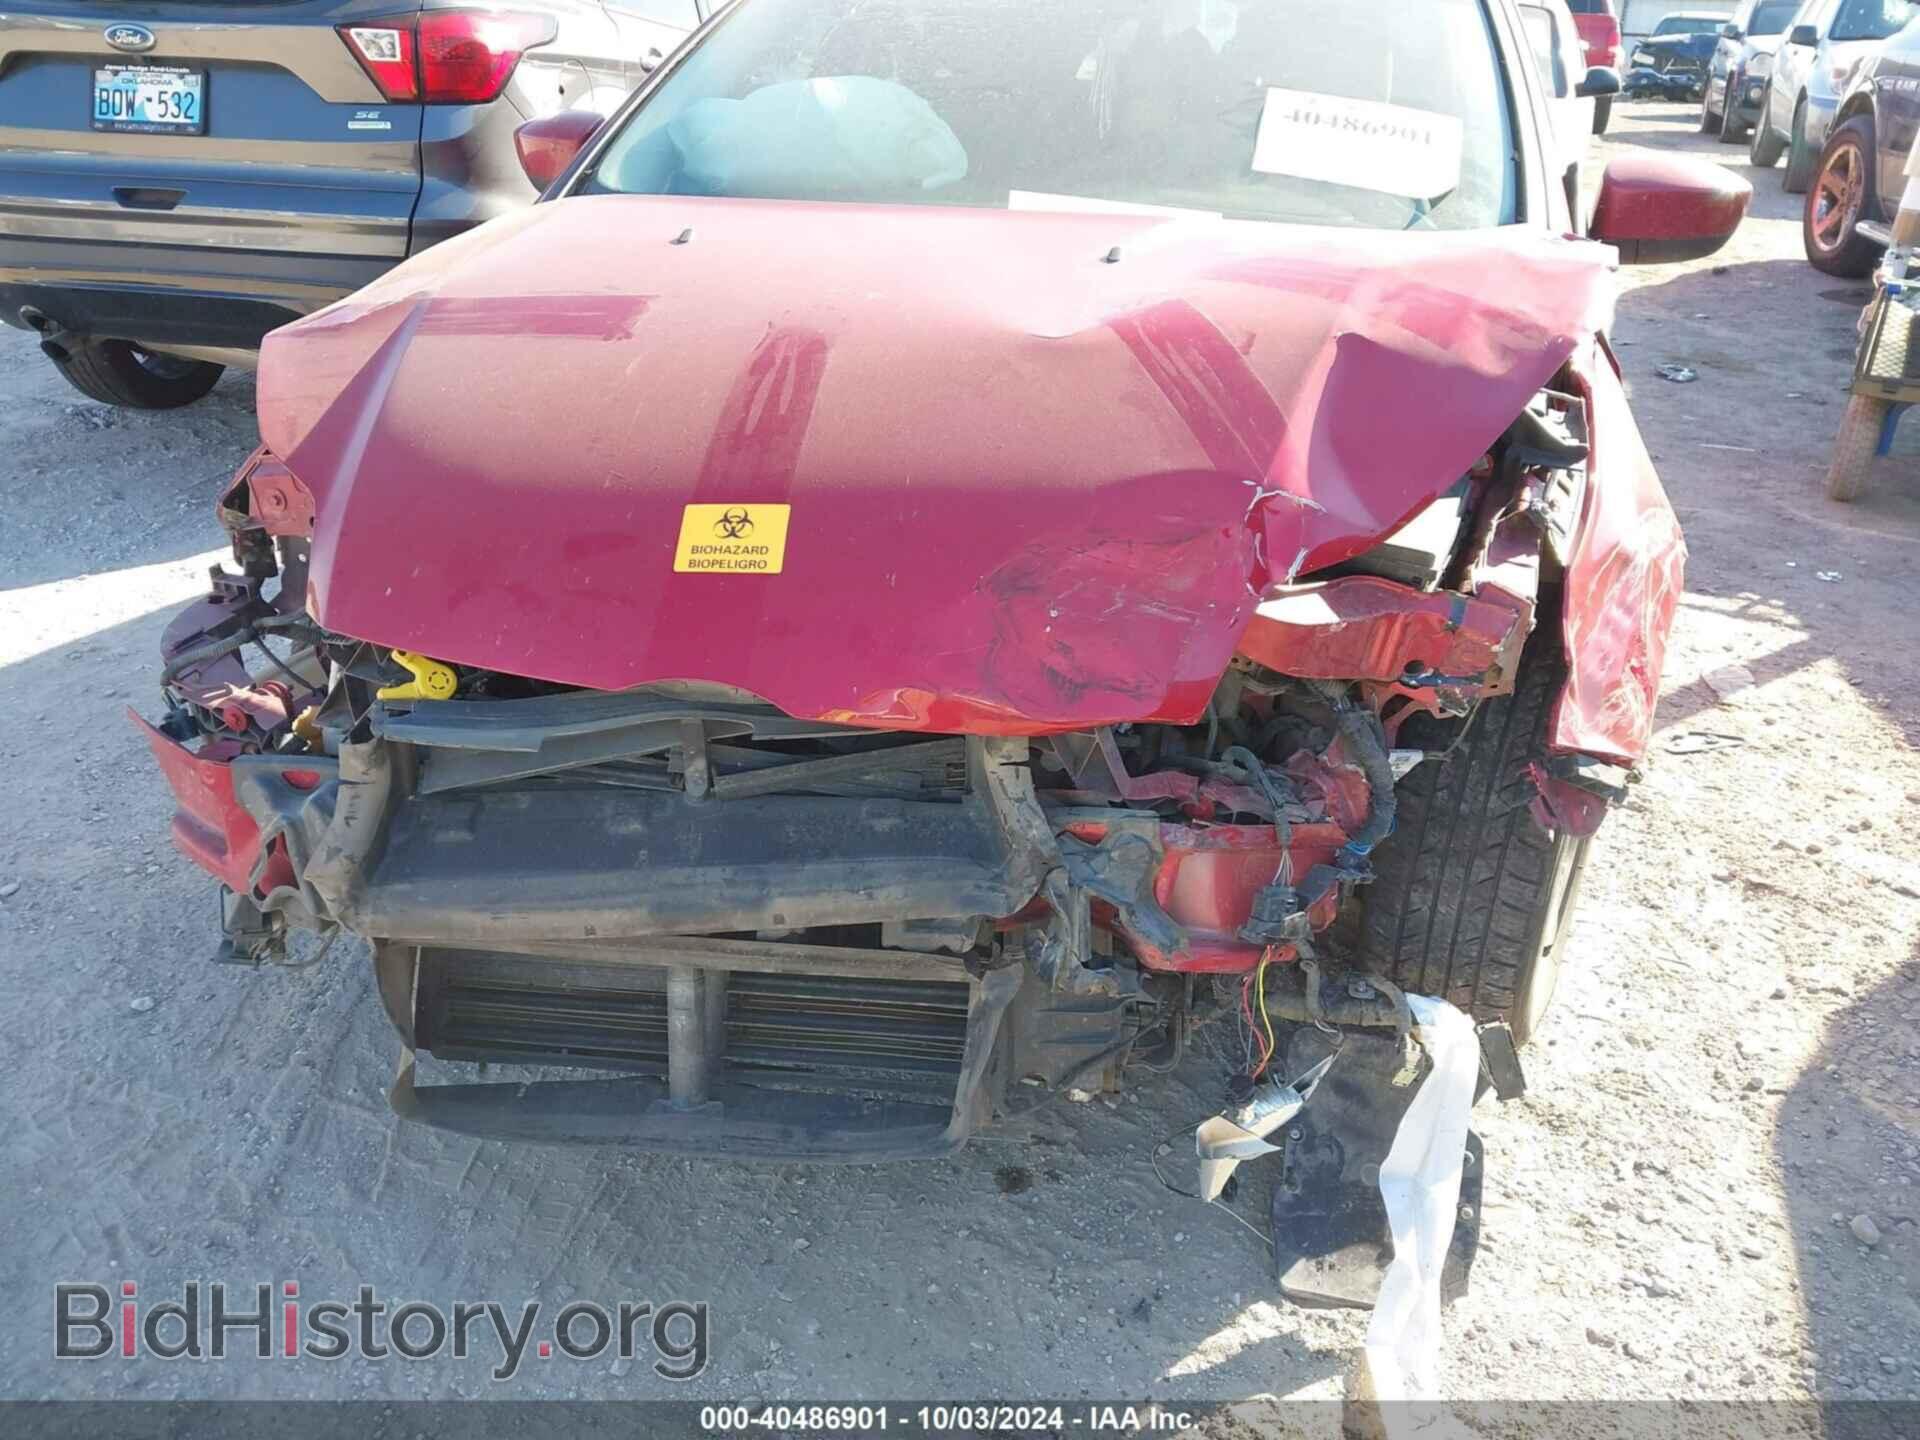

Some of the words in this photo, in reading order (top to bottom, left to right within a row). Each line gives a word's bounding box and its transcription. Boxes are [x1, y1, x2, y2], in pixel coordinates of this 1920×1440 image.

[114, 29, 142, 44] Ford
[121, 78, 173, 86] OKLAHOMA
[98, 88, 136, 117] BOW
[158, 91, 195, 120] 532
[354, 111, 381, 119] SE
[690, 545, 769, 555] BIOHAZARD
[688, 559, 768, 569] BIOPELIGRO
